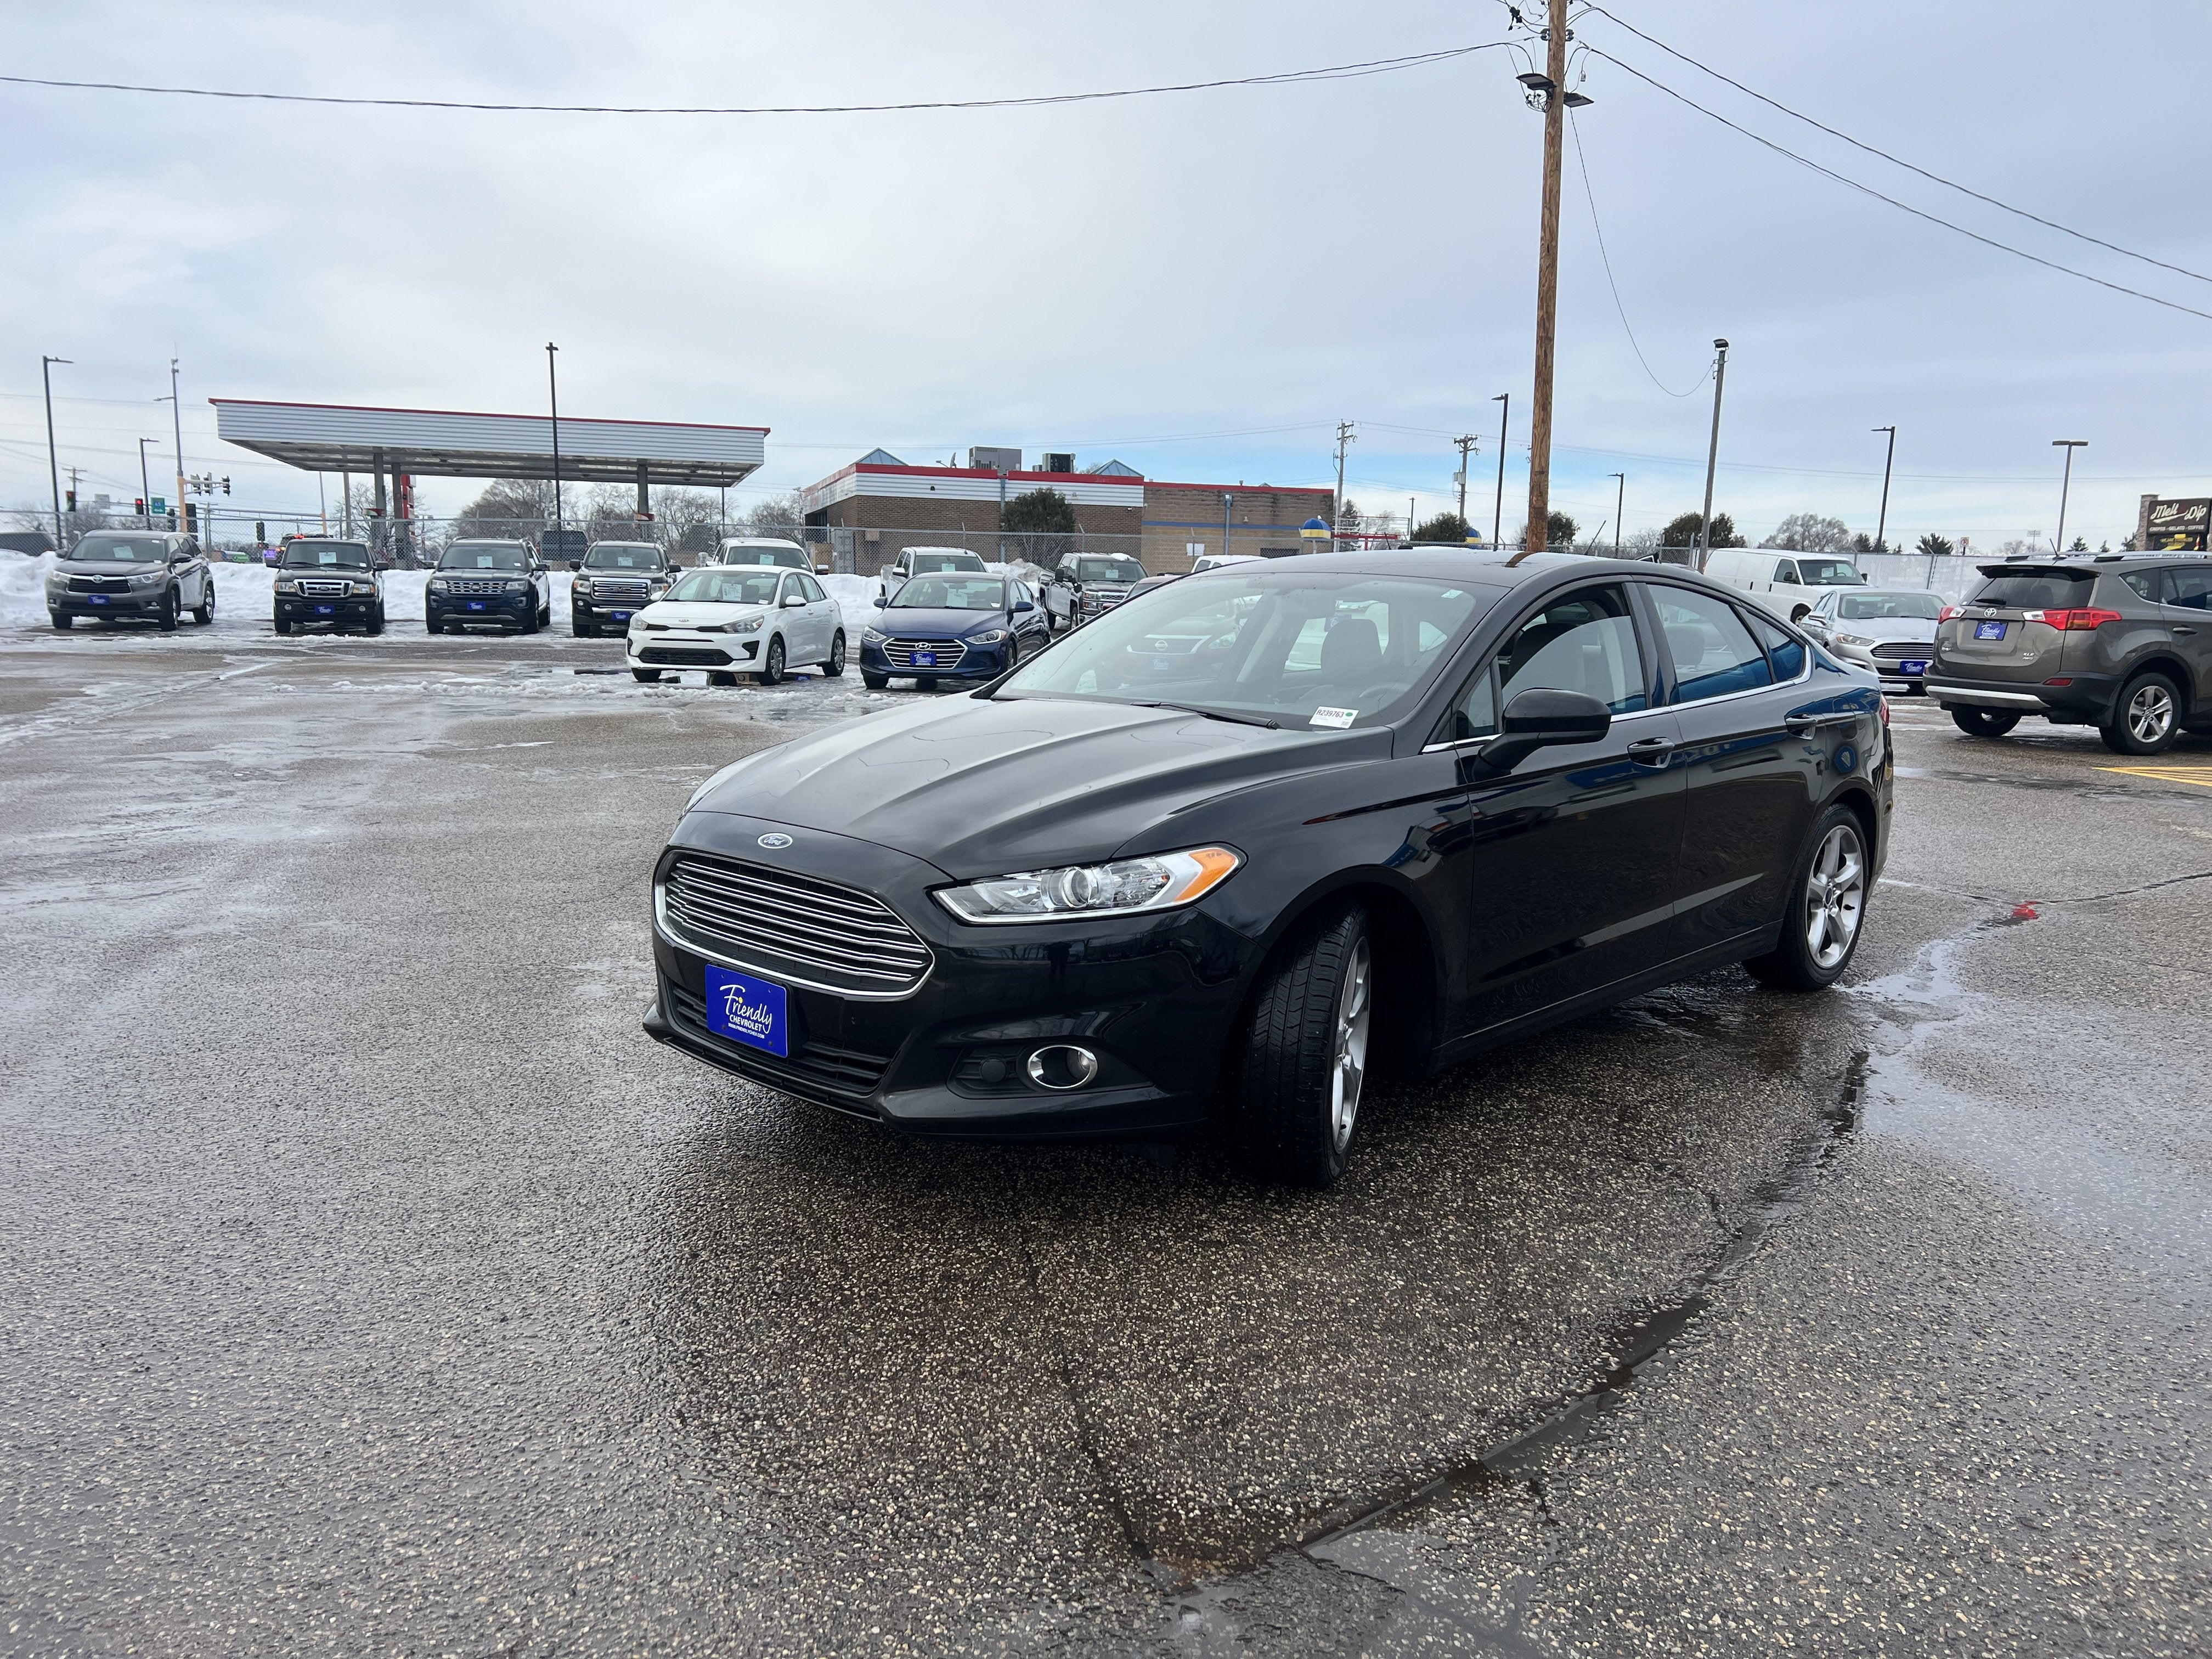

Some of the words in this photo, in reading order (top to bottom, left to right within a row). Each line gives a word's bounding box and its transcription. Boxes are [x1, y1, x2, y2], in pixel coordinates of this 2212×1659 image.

[2150, 503, 2180, 521] Melt
[2183, 504, 2207, 522] Dip
[763, 836, 785, 845] Ford
[719, 984, 772, 1034] Friendly
[729, 1014, 763, 1032] CHEVROLET
